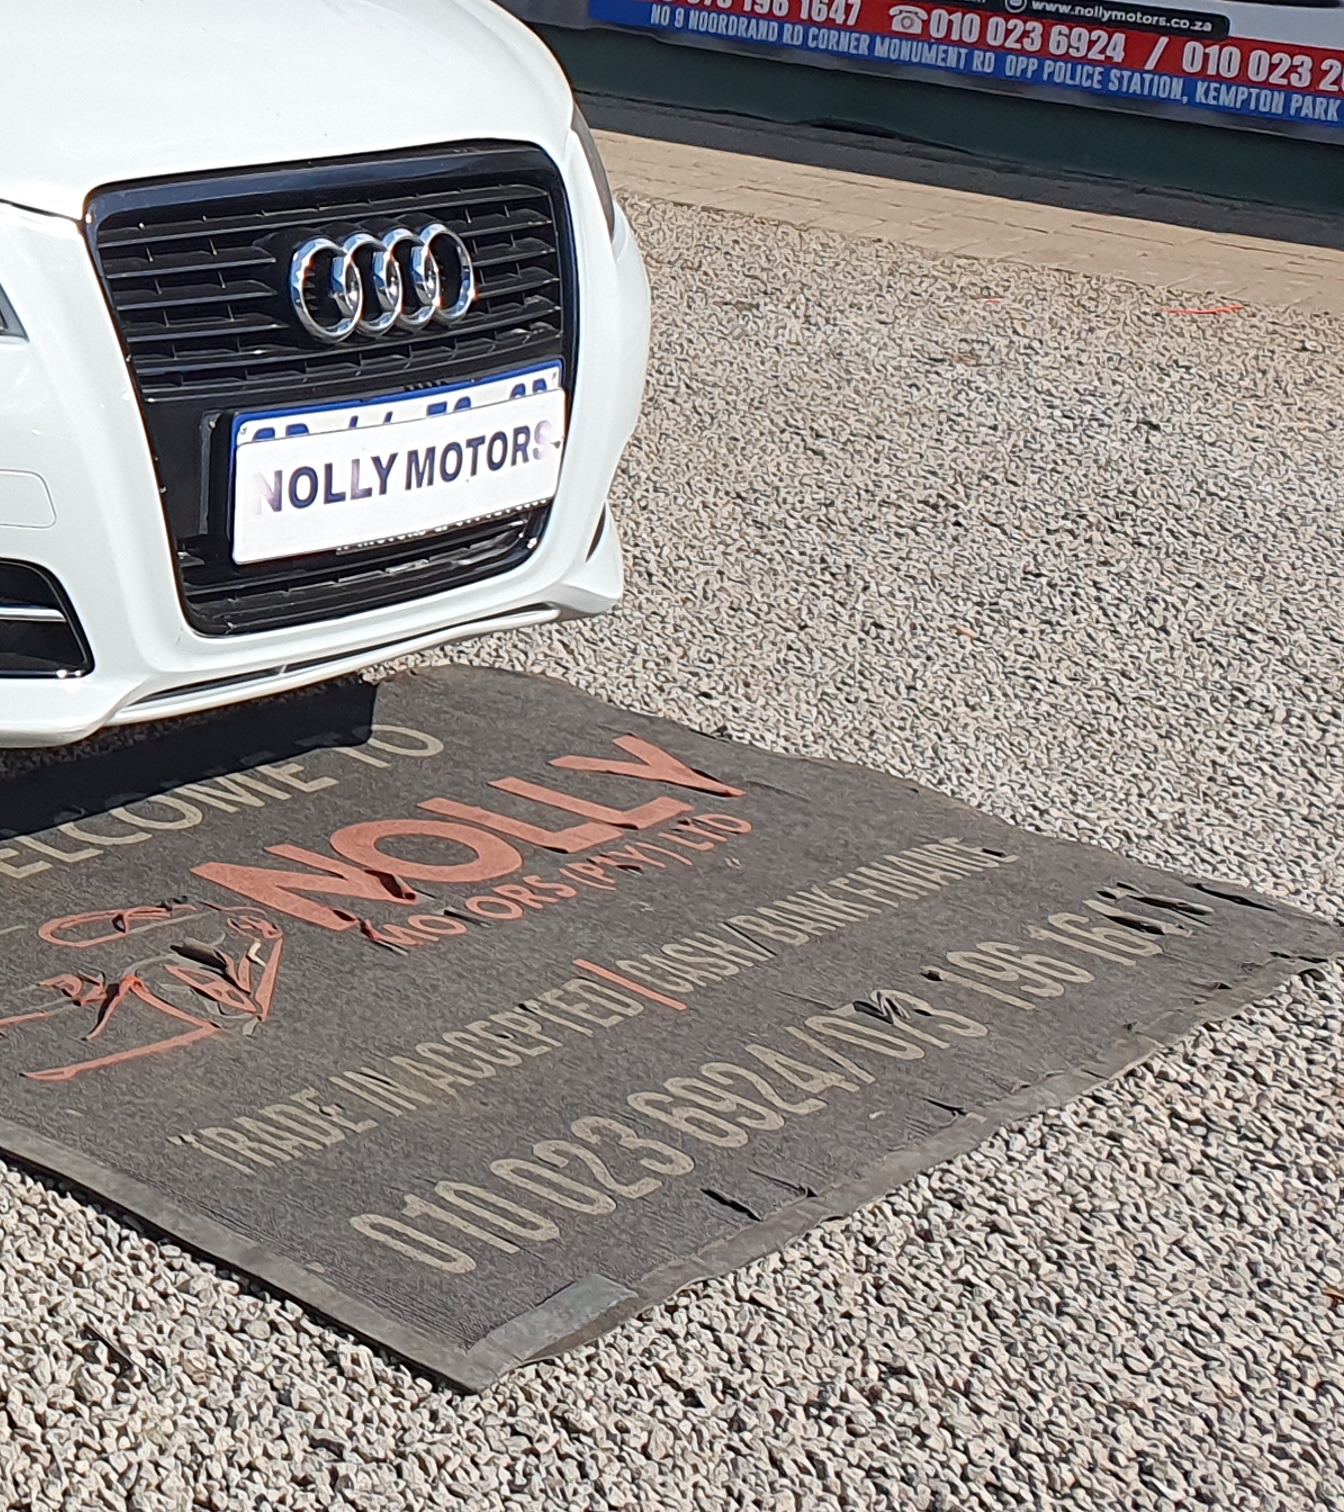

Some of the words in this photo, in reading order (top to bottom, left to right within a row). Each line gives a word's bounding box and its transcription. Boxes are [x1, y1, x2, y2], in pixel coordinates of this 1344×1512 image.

[650, 3, 670, 26] NO
[674, 7, 684, 28] 9
[688, 9, 778, 42] NOORDRAND
[783, 21, 803, 45] RD
[807, 26, 869, 55] CORNER
[873, 36, 968, 69] MONUMENT
[972, 49, 995, 73] RD
[1004, 56, 1038, 79] OPP
[1043, 61, 1102, 89] POLICE
[1108, 70, 1188, 104] STATION,
[1194, 81, 1284, 115] KEMPTON
[1289, 95, 1339, 122] PARK
[929, 8, 980, 44] 010
[986, 18, 1043, 51] 023
[1048, 25, 1126, 63] 6924
[1181, 41, 1241, 78] 010
[1247, 49, 1312, 88] 023
[1319, 59, 1344, 92] 2
[1031, 0, 1213, 32] www.nollymotors.co.za
[255, 451, 399, 514] NOLLY
[404, 418, 555, 491] MOTORS
[296, 723, 445, 769] TO
[190, 733, 747, 931] NOLLY
[362, 875, 578, 955] MOORS
[167, 1087, 379, 1175] TRADE
[328, 1066, 431, 1118] IN
[391, 976, 645, 1094] ACCEPTED
[615, 887, 883, 994] CASH/BANK
[828, 836, 1021, 908] FINANCE
[349, 1180, 560, 1274] 010
[489, 1116, 696, 1215] 023
[919, 941, 1095, 1010] 196
